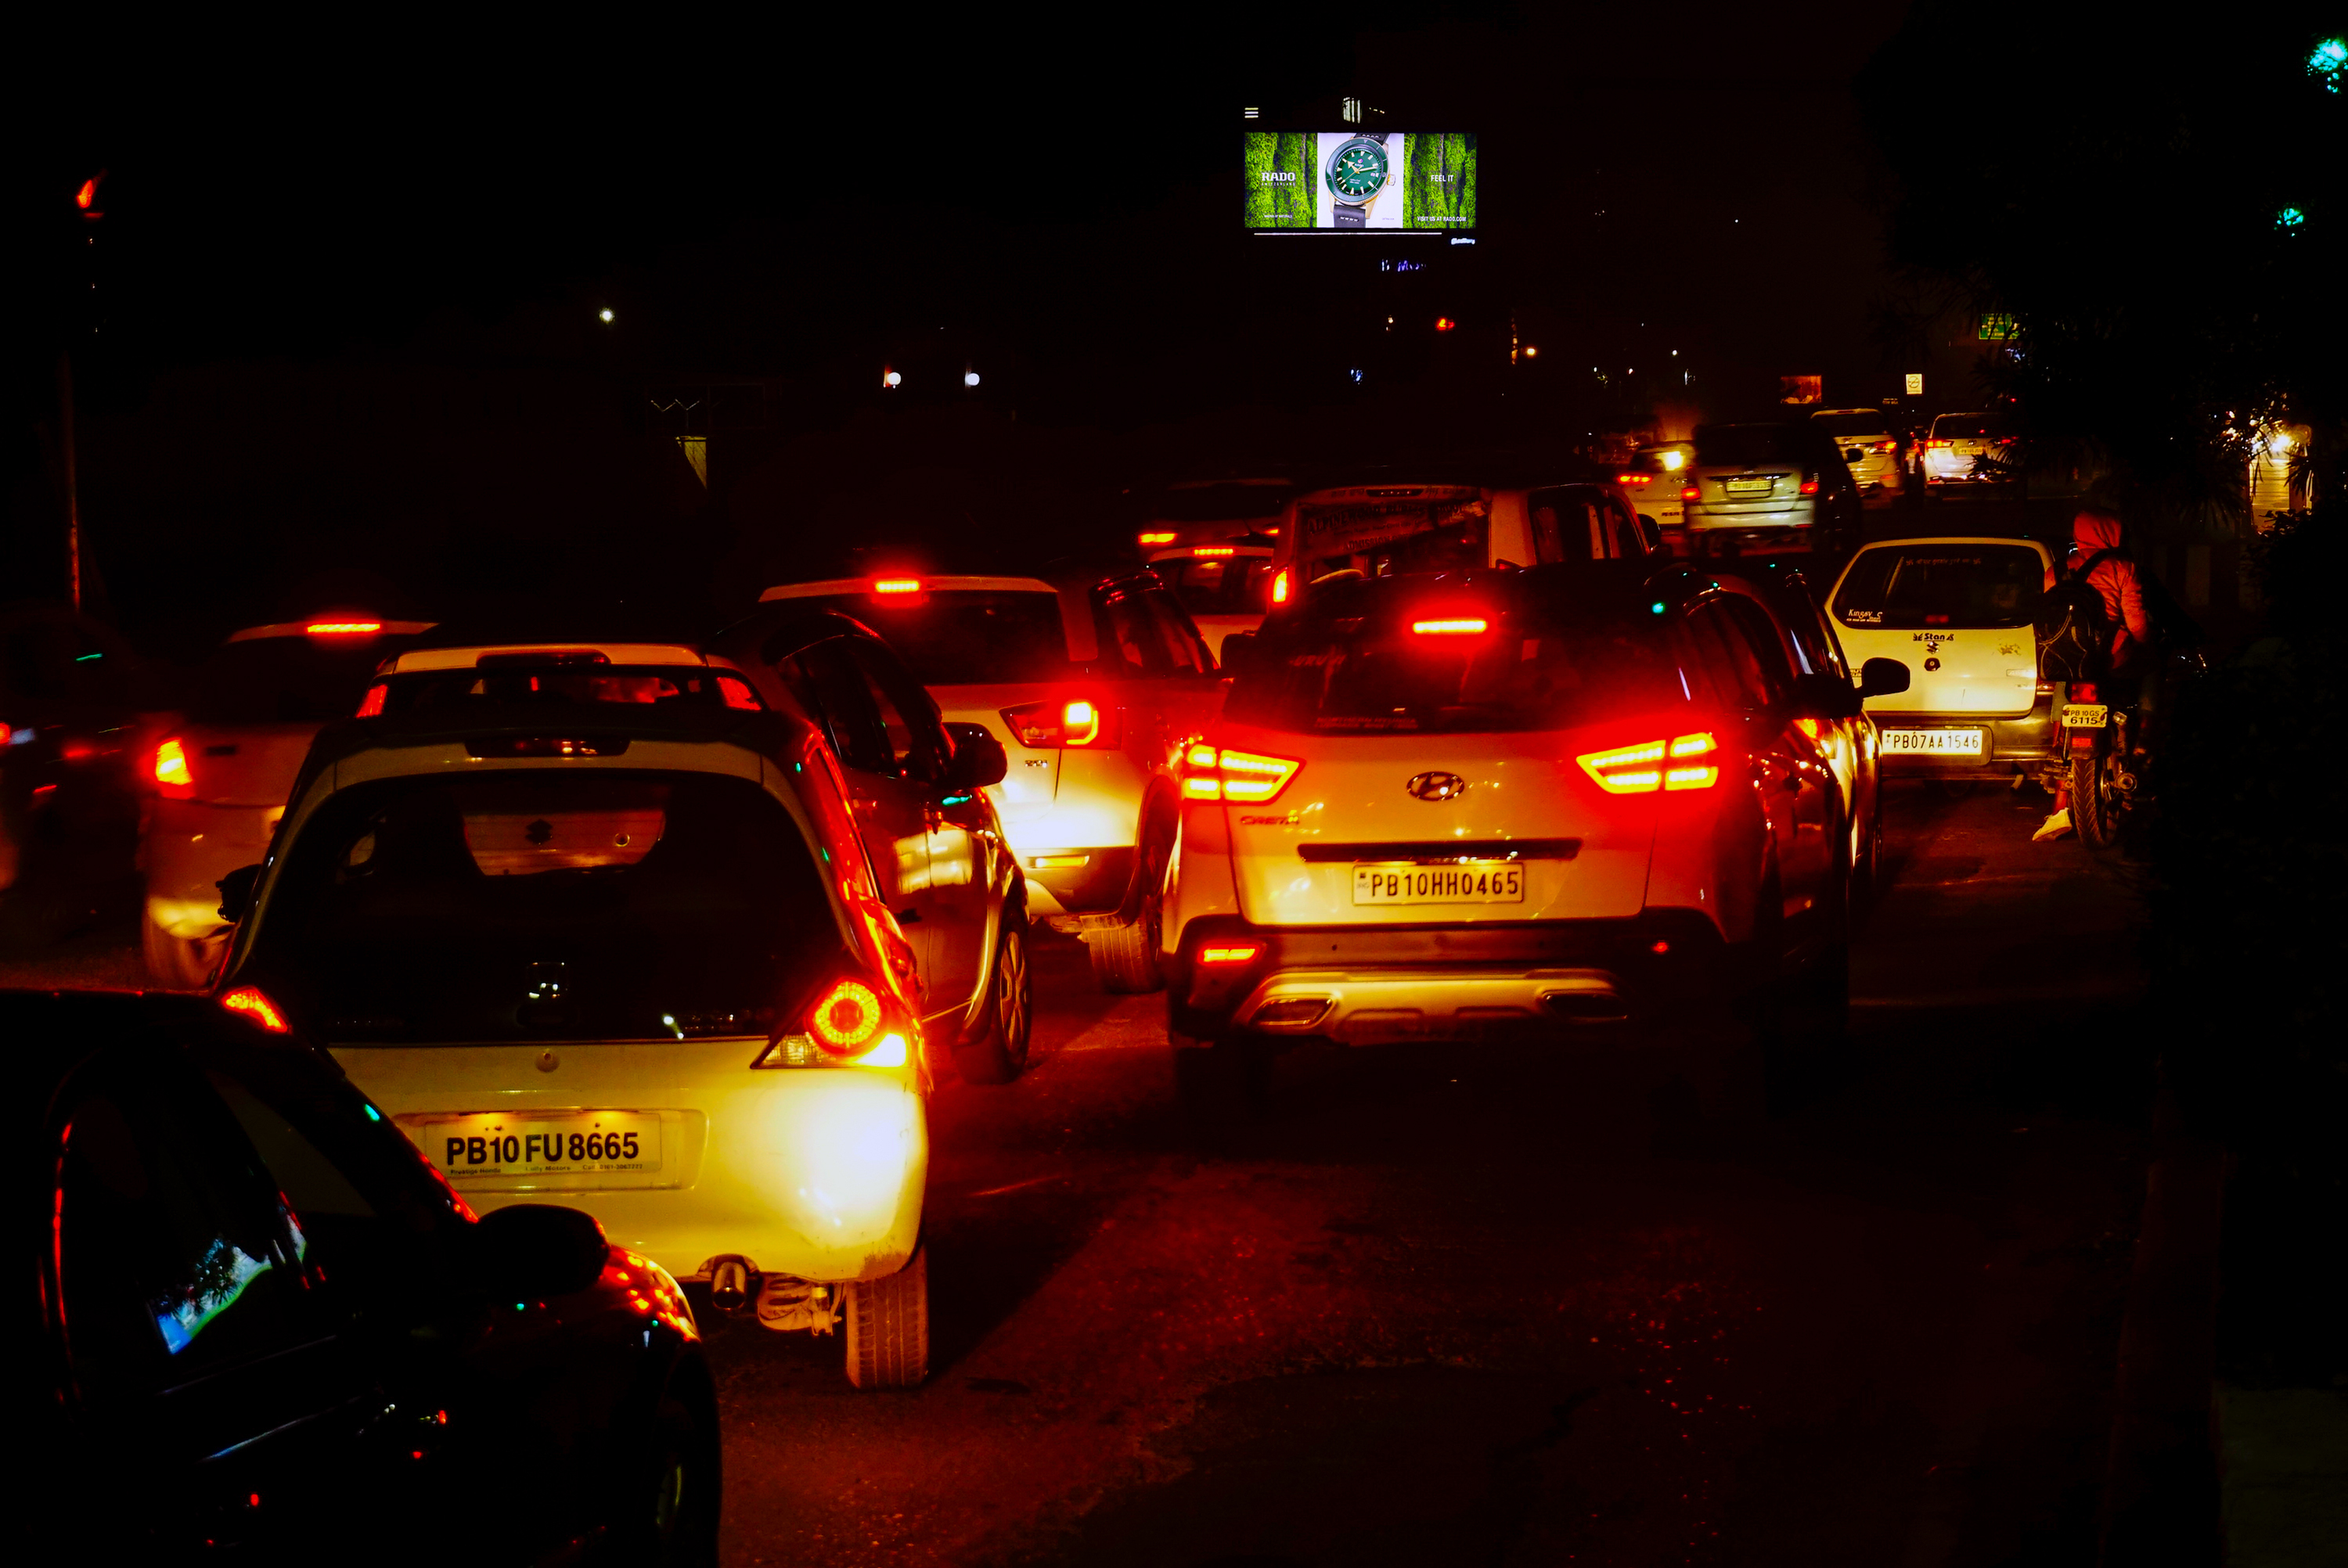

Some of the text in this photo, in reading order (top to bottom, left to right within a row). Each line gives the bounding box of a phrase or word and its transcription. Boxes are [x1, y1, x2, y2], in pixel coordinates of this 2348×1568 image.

[1261, 172, 1296, 182] RADO
[2070, 716, 2098, 725] 6115
[1893, 734, 1979, 749] PB07AA1546
[1372, 871, 1519, 897] PB10HH0465
[525, 1133, 564, 1163] FU
[568, 1131, 639, 1161] 8665
